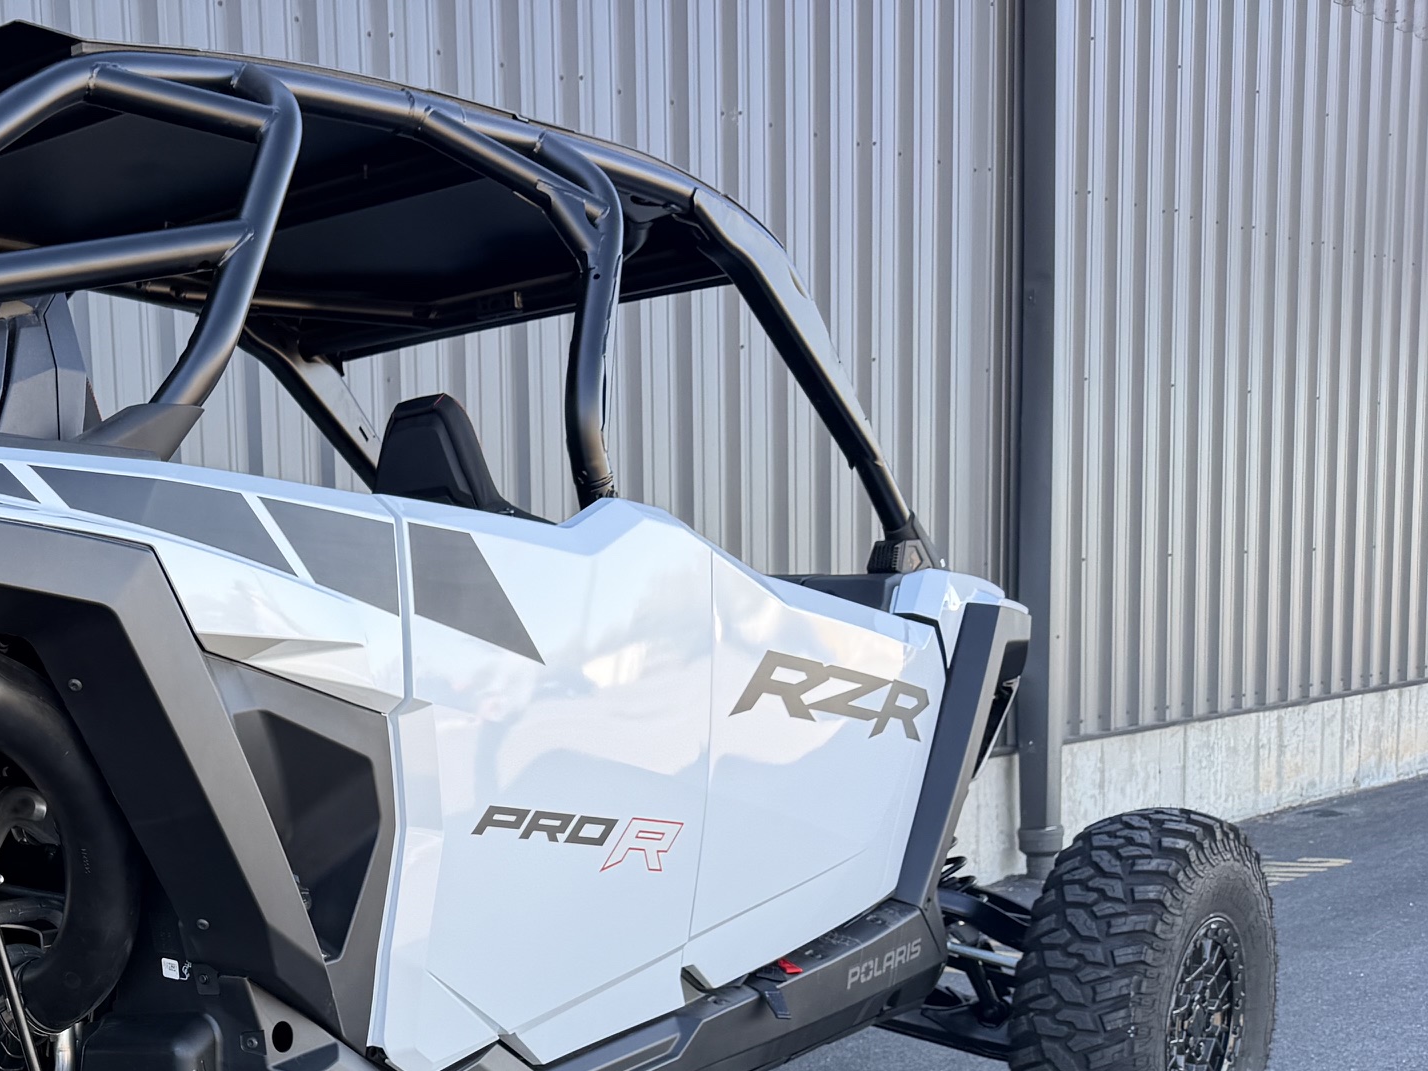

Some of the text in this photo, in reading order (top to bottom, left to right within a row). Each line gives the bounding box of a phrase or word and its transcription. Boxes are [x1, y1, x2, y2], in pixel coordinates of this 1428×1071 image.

[728, 650, 930, 742] RZR
[471, 805, 684, 872] PRO R
[847, 938, 922, 990] POLARIS
